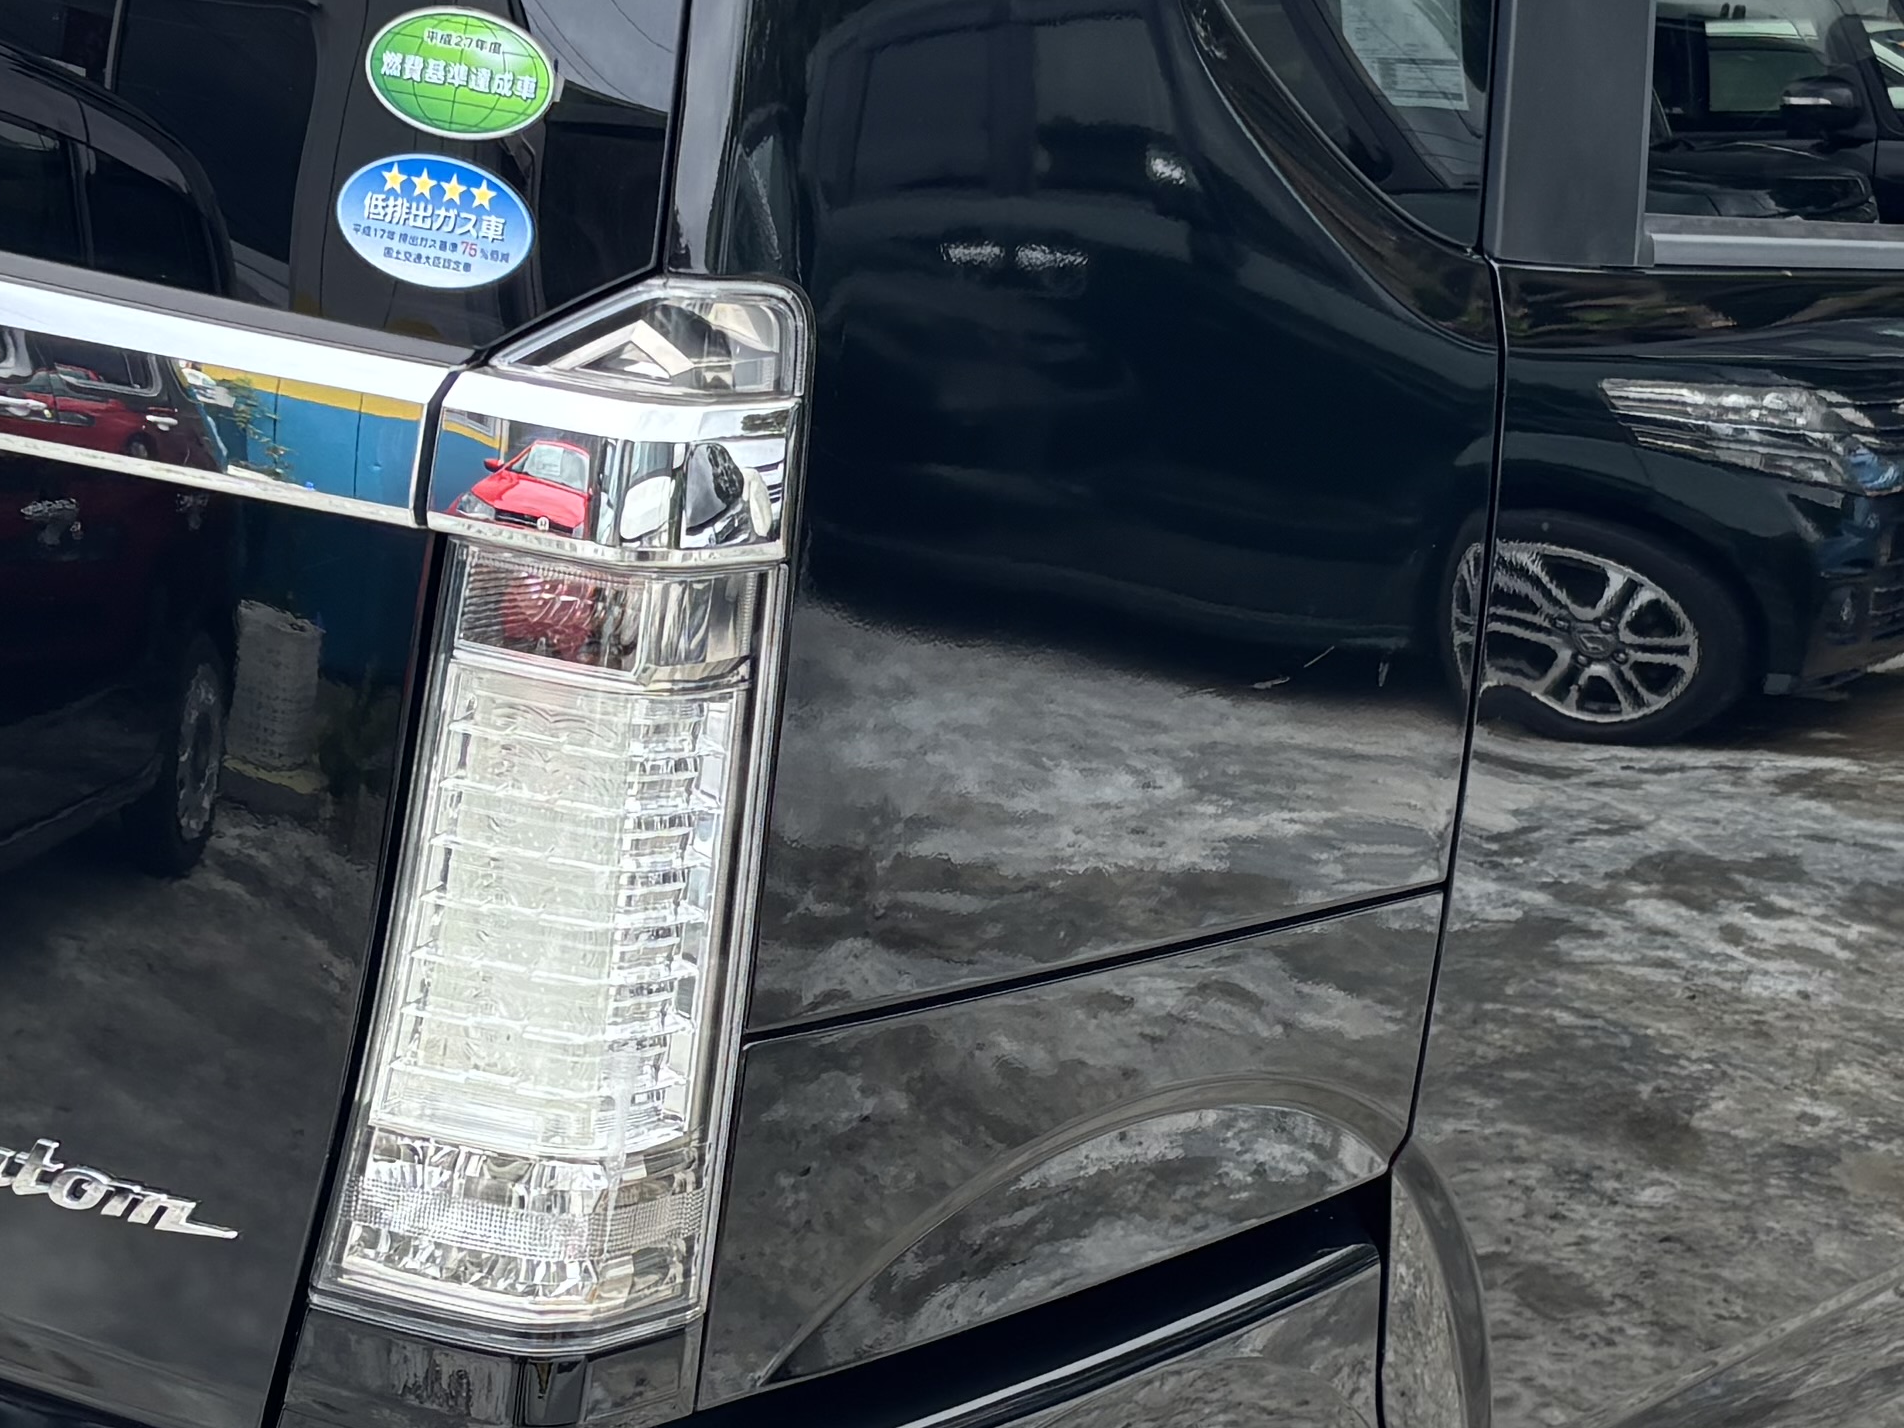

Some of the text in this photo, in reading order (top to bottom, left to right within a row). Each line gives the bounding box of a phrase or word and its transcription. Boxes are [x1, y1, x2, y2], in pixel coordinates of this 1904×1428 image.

[363, 190, 506, 243] 低排出ガス車
